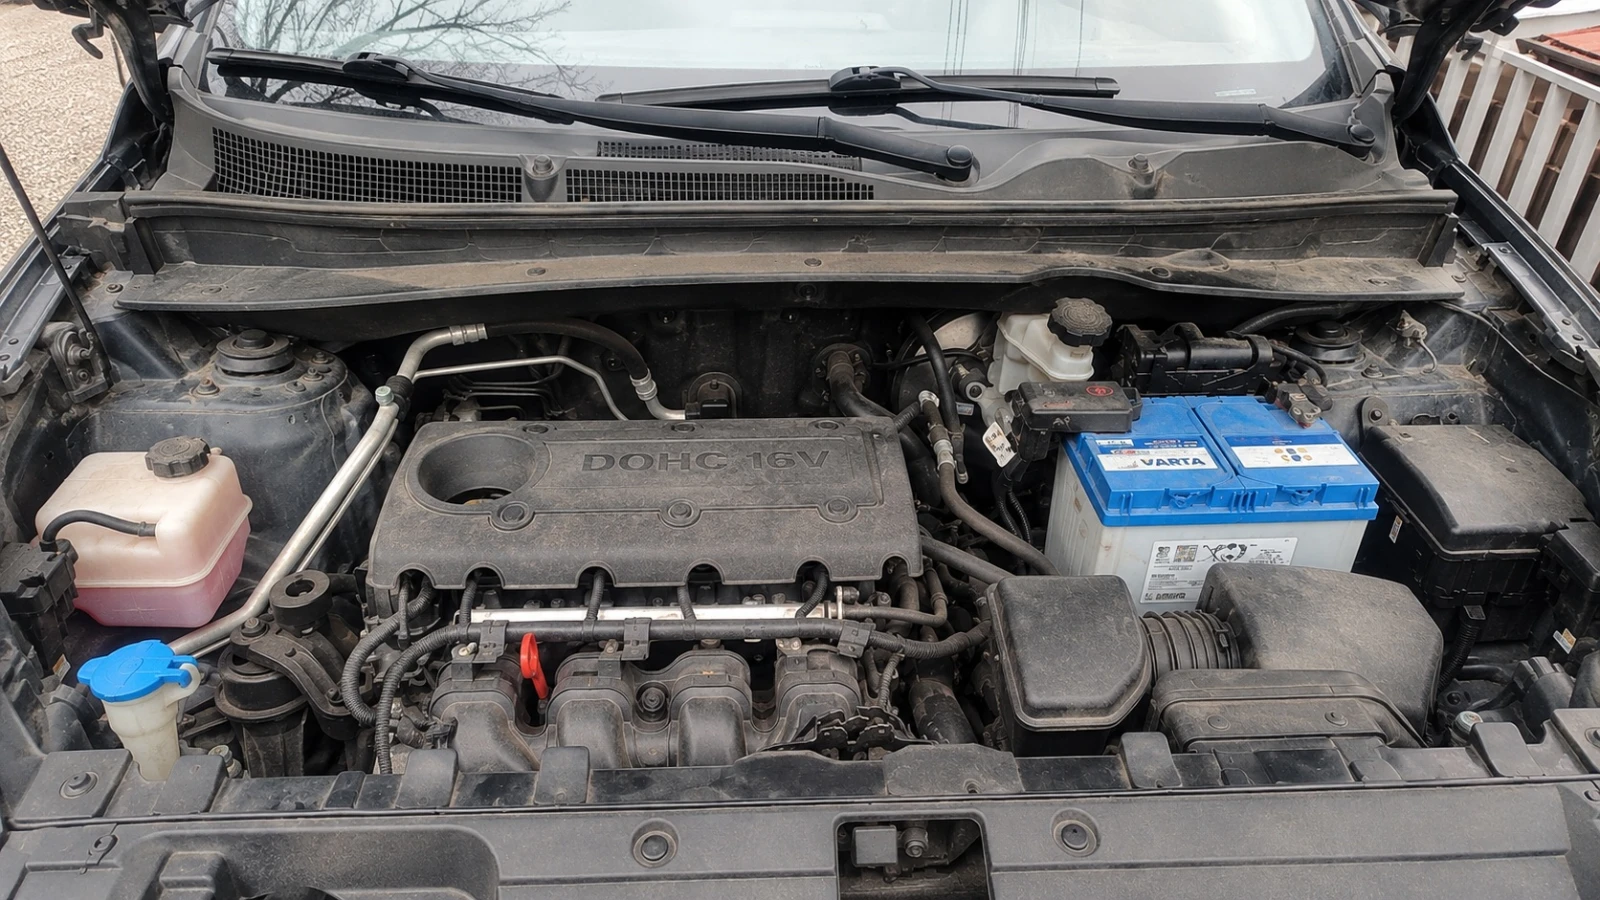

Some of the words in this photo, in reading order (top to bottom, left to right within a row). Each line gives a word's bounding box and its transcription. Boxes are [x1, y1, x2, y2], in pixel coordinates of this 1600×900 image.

[582, 451, 728, 471] DOHC
[747, 450, 830, 470] 16V
[1140, 457, 1206, 467] VARTA
